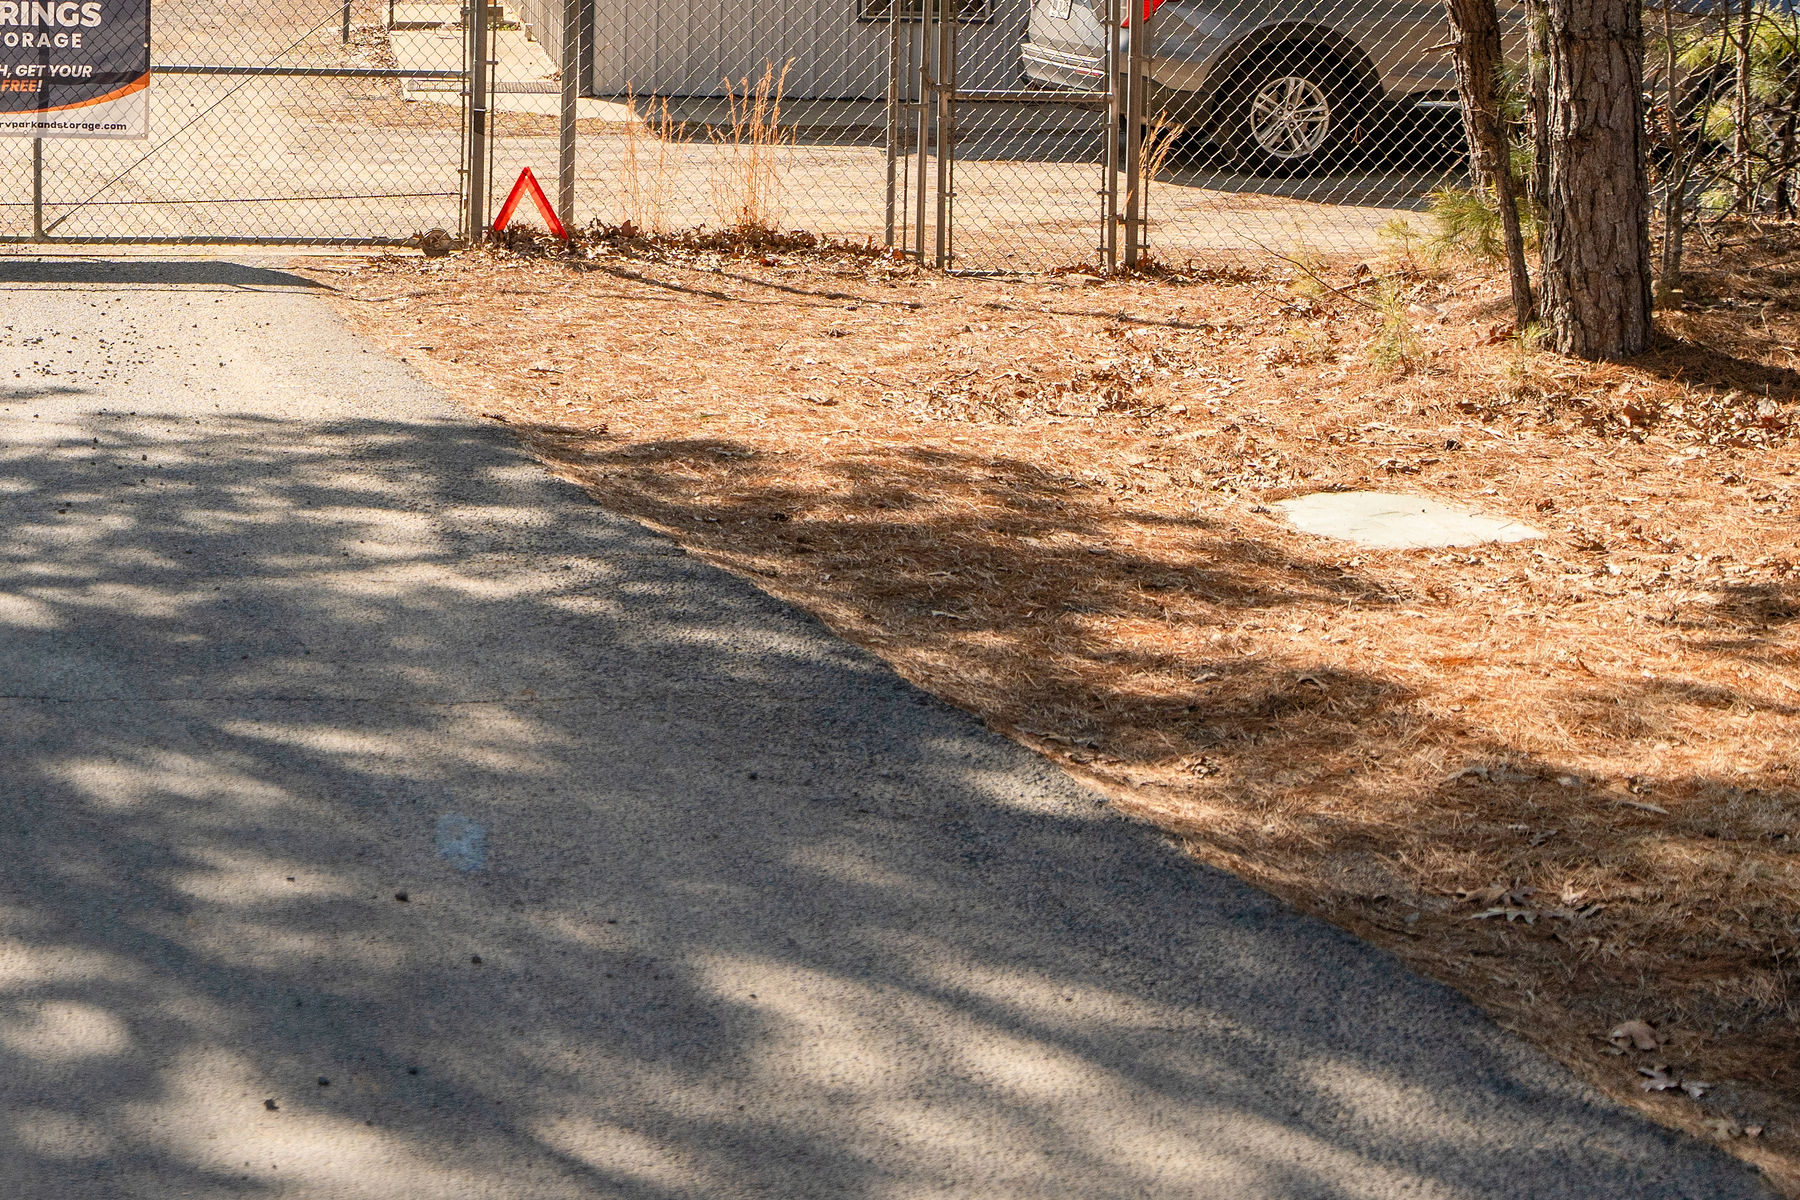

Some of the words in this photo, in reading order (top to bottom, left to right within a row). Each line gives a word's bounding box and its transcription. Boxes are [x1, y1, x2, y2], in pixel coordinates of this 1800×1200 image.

[15, 64, 47, 77] GET
[48, 64, 93, 78] YOUR
[0, 79, 43, 93] FREE!
